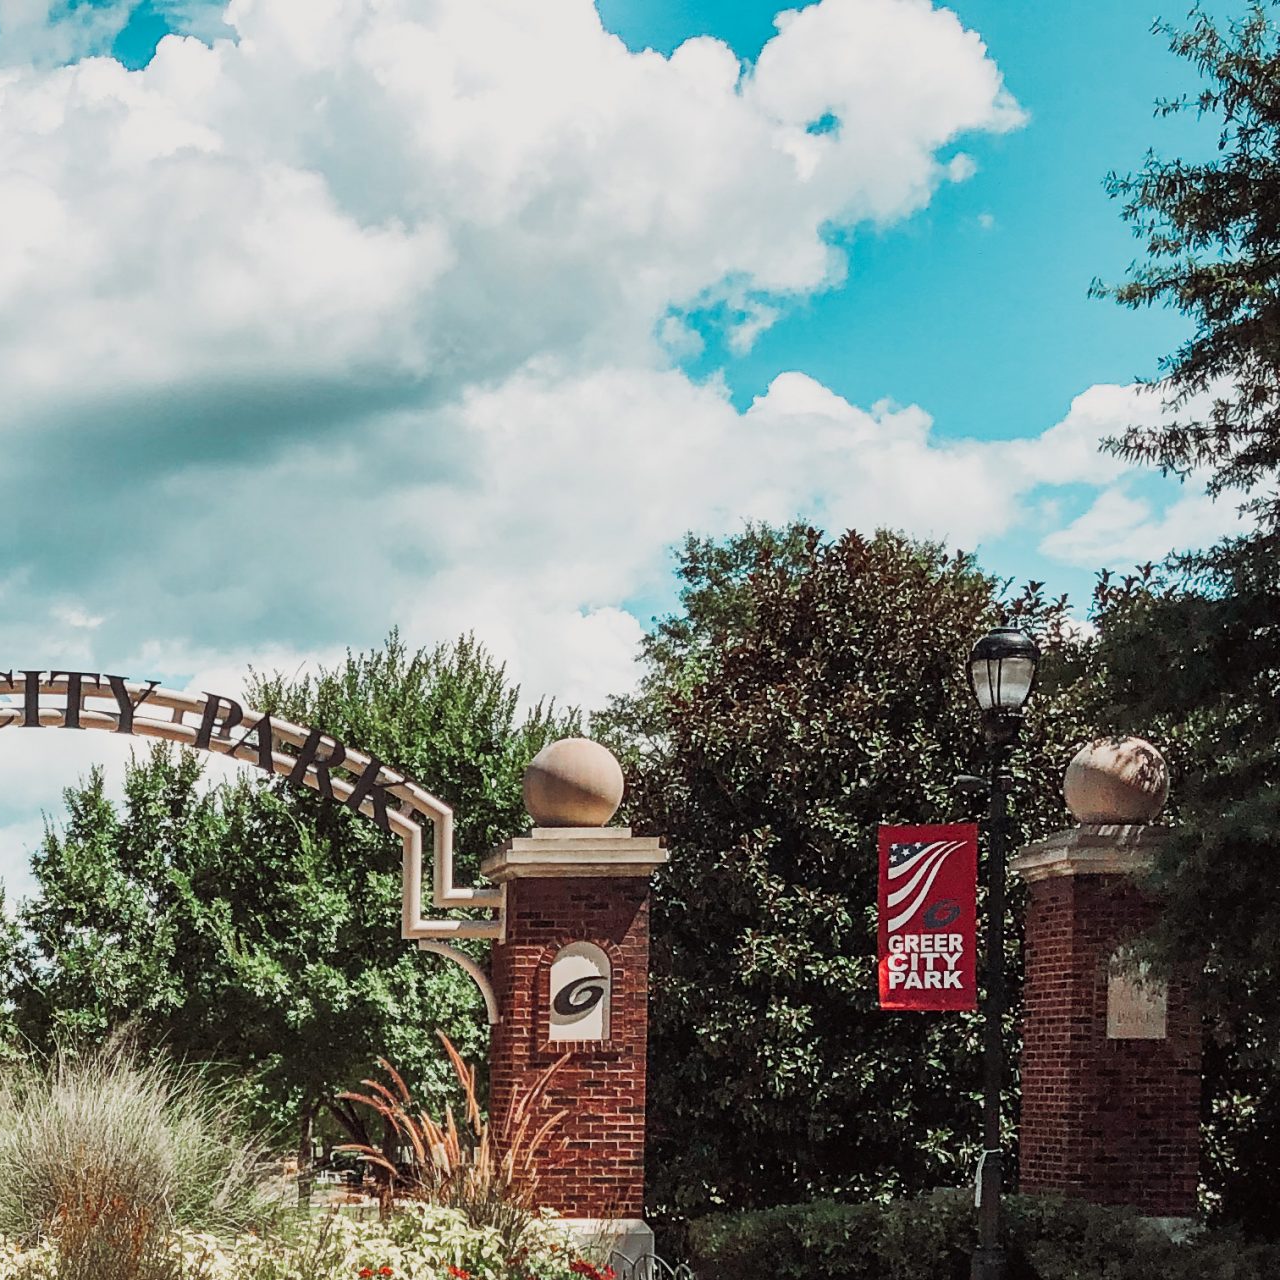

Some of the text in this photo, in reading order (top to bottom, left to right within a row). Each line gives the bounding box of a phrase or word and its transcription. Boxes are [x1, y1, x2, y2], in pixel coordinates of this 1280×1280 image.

[192, 691, 413, 833] PARK
[888, 934, 964, 953] GREER
[887, 952, 962, 971] CITY
[888, 970, 964, 989] PARK
